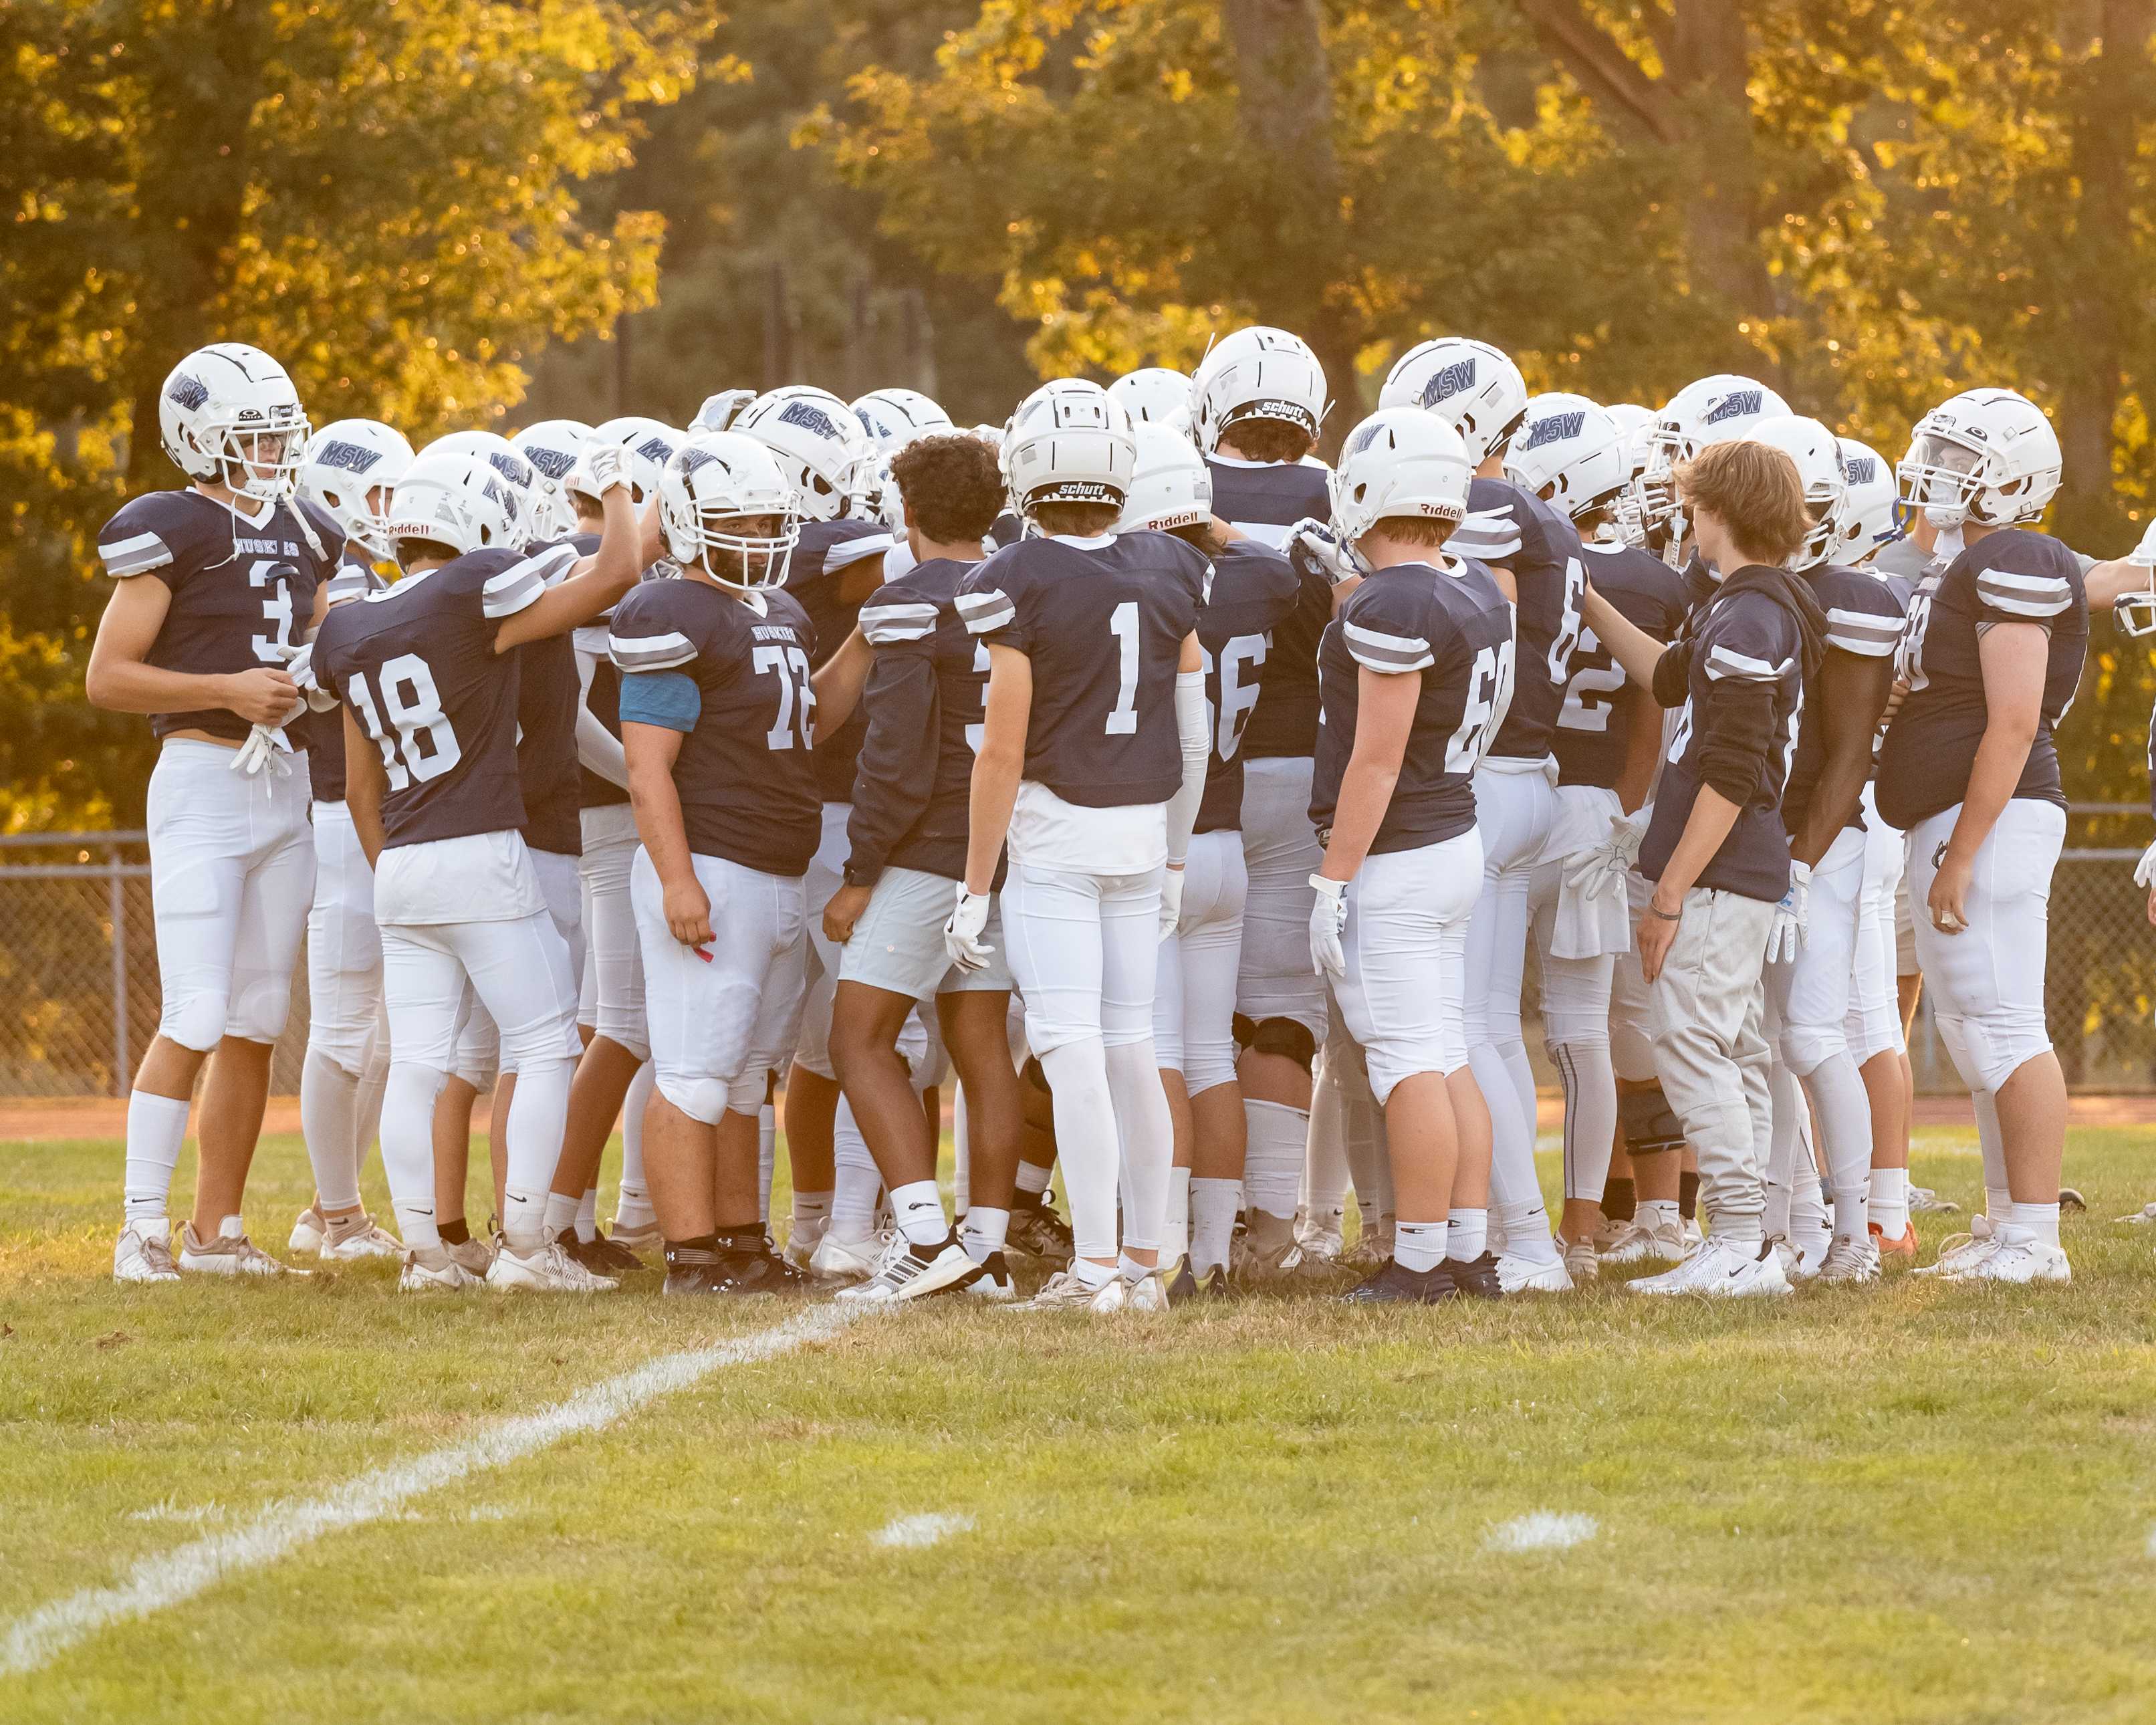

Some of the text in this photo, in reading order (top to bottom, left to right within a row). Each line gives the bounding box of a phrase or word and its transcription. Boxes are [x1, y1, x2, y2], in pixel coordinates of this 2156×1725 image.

[1423, 358, 1475, 410] MSW
[777, 401, 836, 440] MSW
[1262, 400, 1304, 419] schutt
[1708, 390, 1762, 425] MSW
[1527, 411, 1586, 451] MSW
[316, 440, 383, 475] MSW
[523, 446, 578, 480] MSW
[1846, 458, 1876, 486] SW
[1058, 481, 1105, 495] schutt
[1149, 512, 1197, 530] Riddell
[1421, 503, 1463, 519] Riddell
[388, 524, 429, 535] Riddell
[249, 560, 293, 662] 3
[1105, 602, 1140, 735] 1
[348, 653, 462, 791] 18
